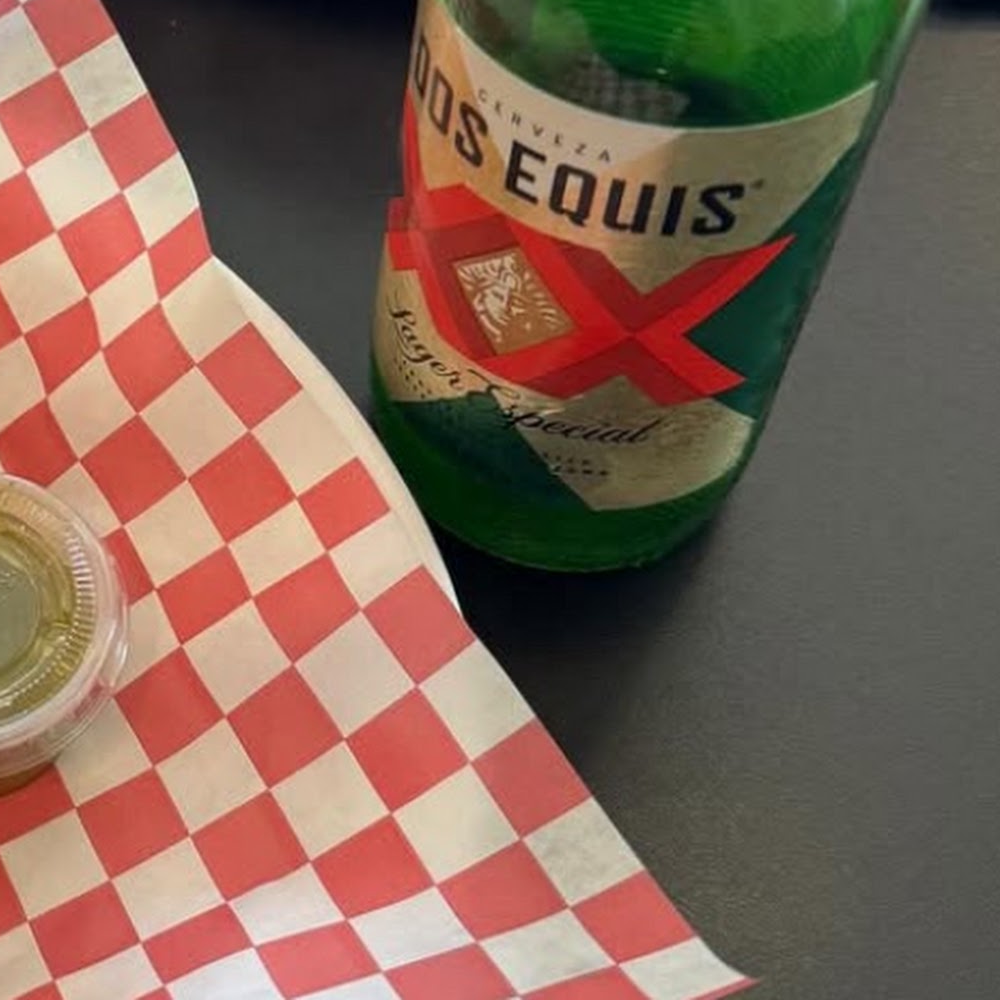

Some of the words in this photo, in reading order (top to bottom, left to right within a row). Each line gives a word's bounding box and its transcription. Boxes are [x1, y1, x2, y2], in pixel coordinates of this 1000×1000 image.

[414, 32, 488, 168] DOS
[505, 139, 745, 237] EQUIS
[478, 89, 611, 163] CERVEZA
[386, 290, 464, 390] Lager
[466, 367, 660, 443] Especial
